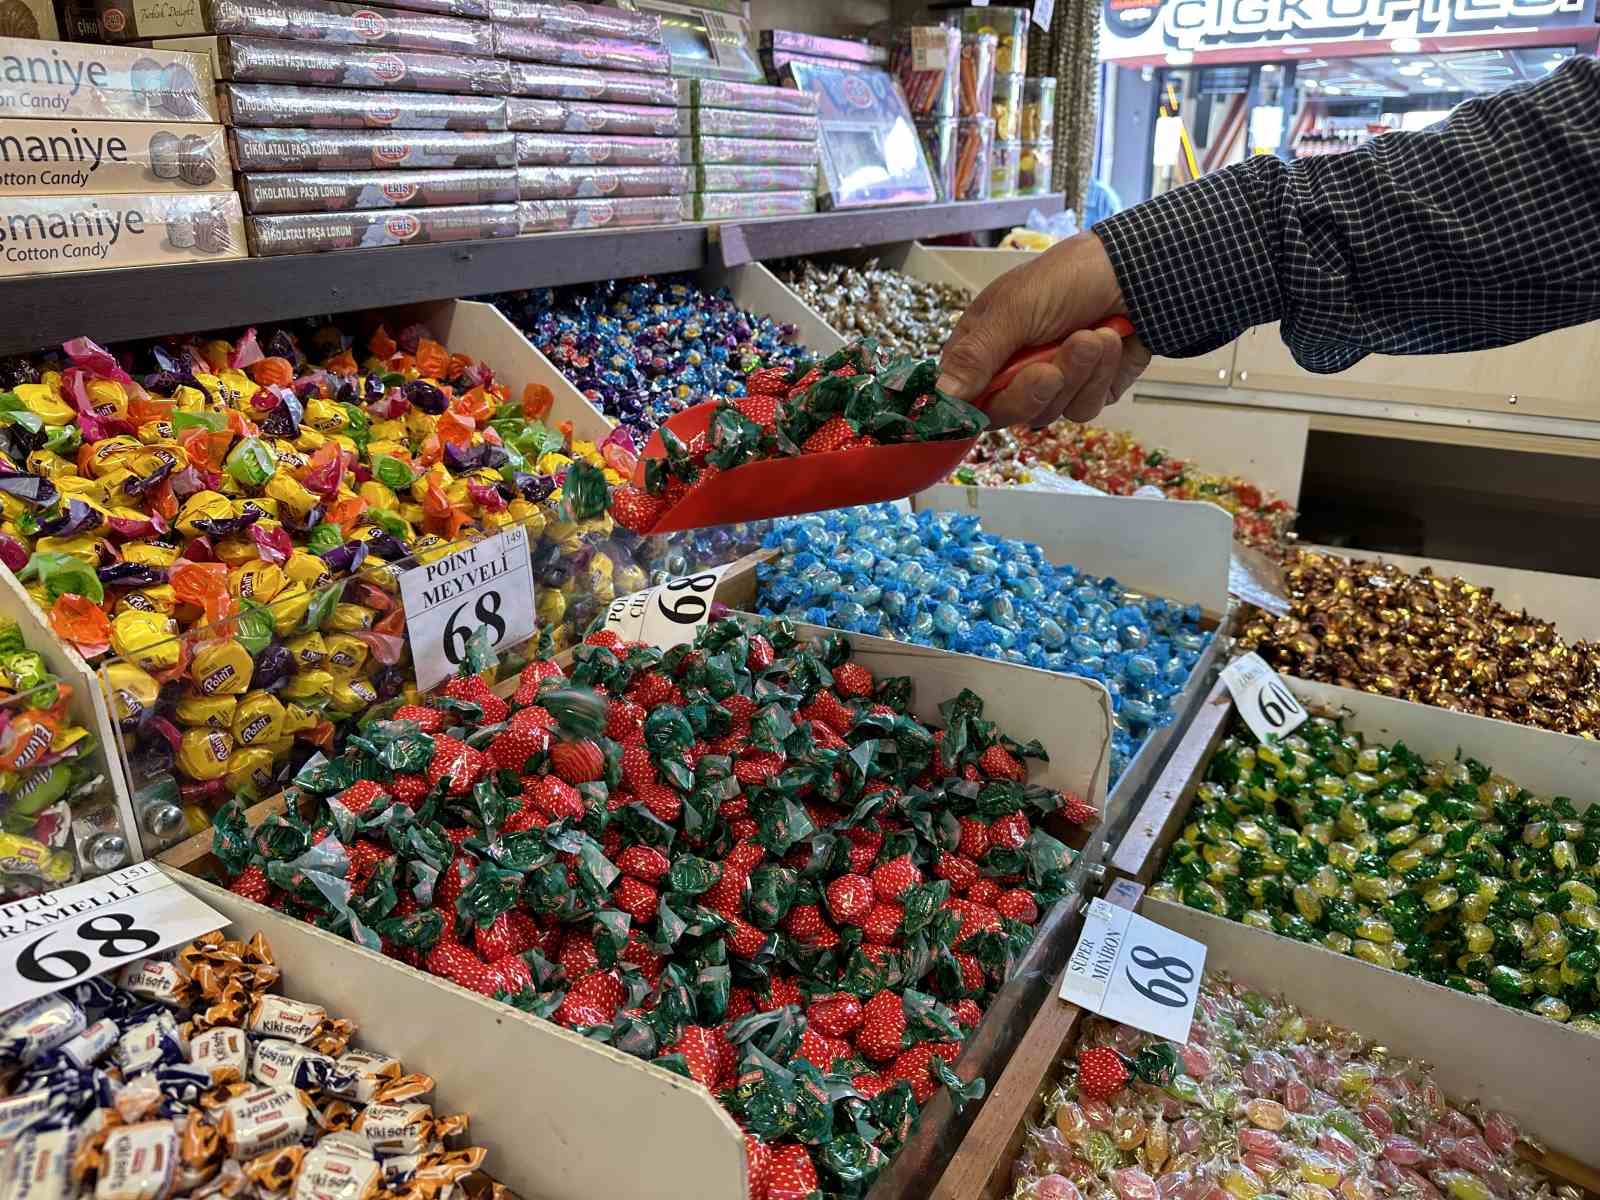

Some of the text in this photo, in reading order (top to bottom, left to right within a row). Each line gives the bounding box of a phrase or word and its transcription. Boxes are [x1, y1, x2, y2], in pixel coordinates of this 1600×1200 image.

[20, 92, 70, 112] Candy
[0, 170, 89, 188] tton Candy
[300, 186, 320, 200] PAŞA
[320, 185, 346, 197] LOKUM
[327, 224, 353, 237] LOKUM
[6, 243, 109, 262] Cotton Candy
[505, 529, 522, 546] 149
[422, 552, 509, 608] MEYVELİ
[658, 574, 717, 625] 68
[443, 590, 506, 664] 68
[1258, 681, 1299, 727] 60
[16, 913, 161, 983] 68
[1071, 938, 1095, 975] SÜPER
[1091, 927, 1121, 984] MİNİBON
[127, 974, 145, 988] Kiki
[1126, 945, 1194, 1008] 68
[262, 1019, 284, 1033] Kiki
[365, 1125, 417, 1139] Kiki soft
